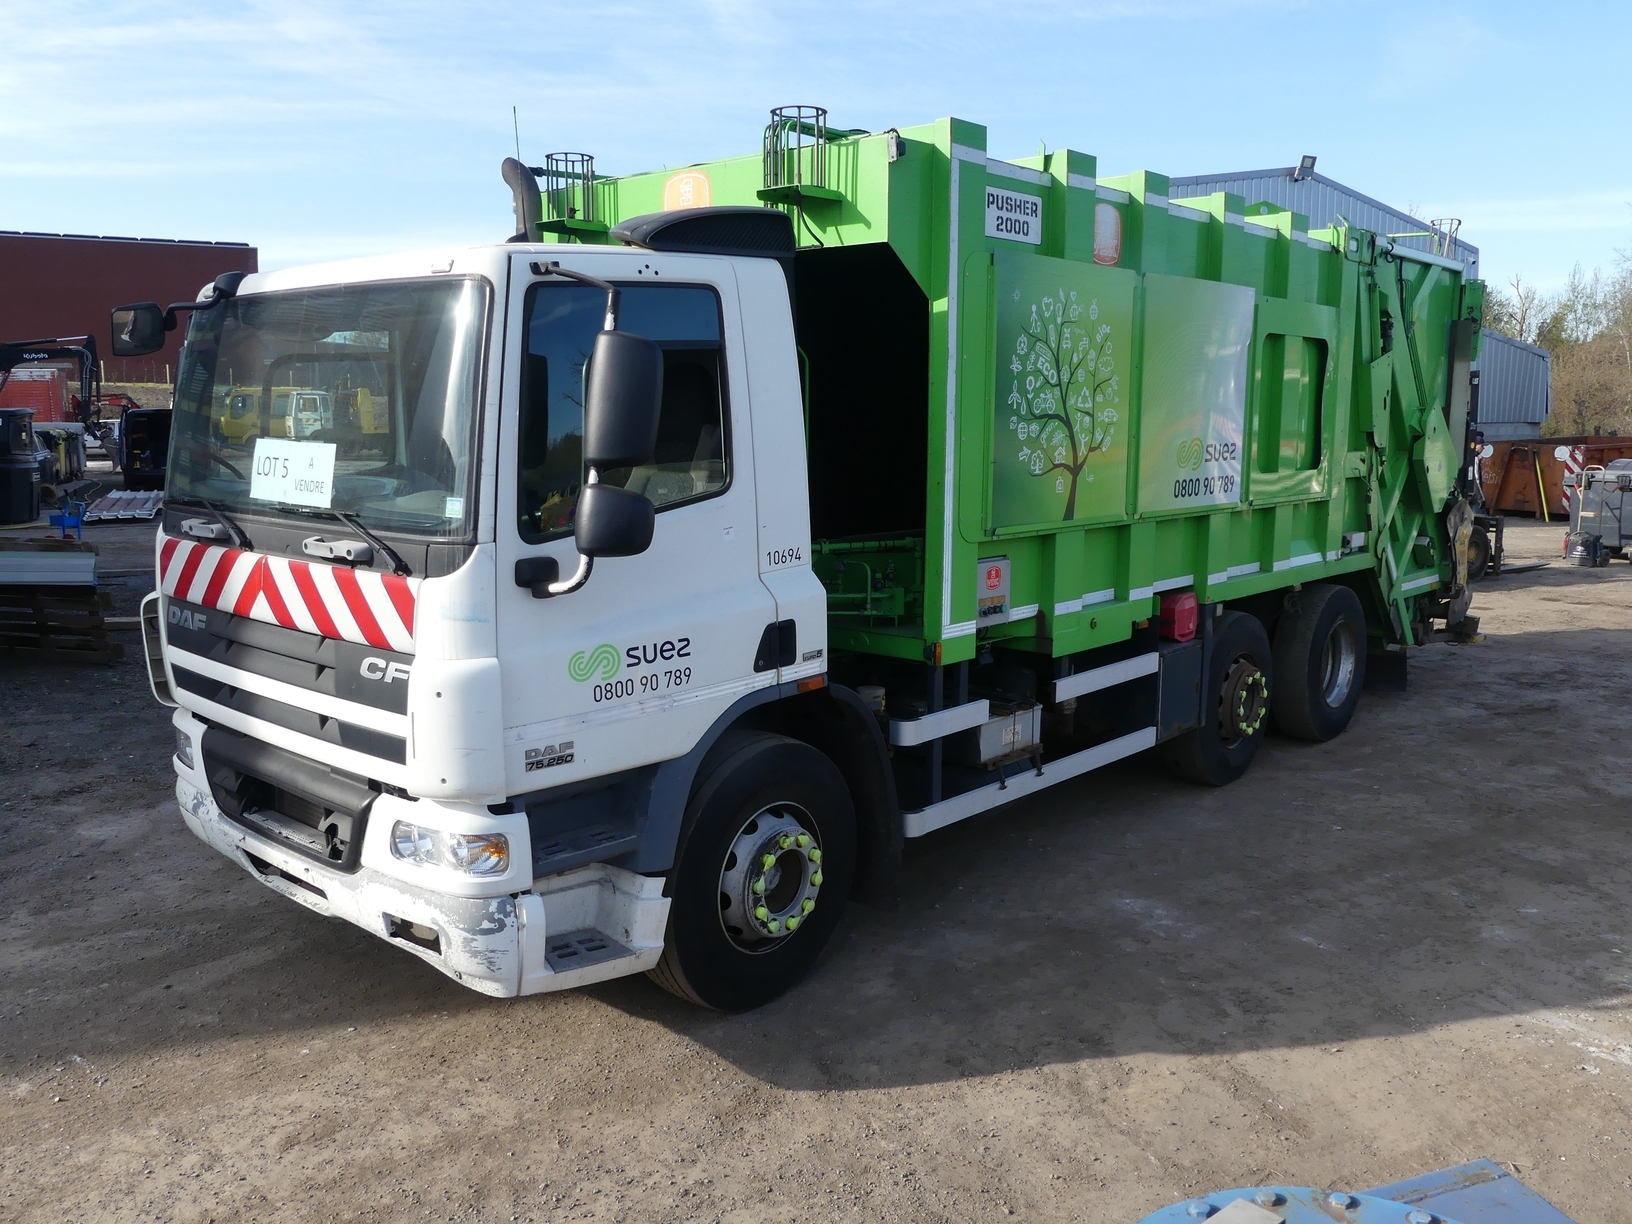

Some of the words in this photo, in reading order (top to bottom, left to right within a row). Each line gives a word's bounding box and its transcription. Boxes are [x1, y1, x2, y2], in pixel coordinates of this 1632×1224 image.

[987, 192, 1038, 218] PUSHER
[996, 215, 1029, 237] 2000
[1037, 357, 1057, 383] ECO
[257, 456, 280, 478] LOT
[281, 457, 290, 479] 5
[308, 456, 315, 470] A
[294, 478, 326, 494] VENDRE
[1173, 477, 1201, 499] 0800
[1203, 476, 1216, 496] 90
[1218, 474, 1235, 494] 789
[766, 547, 802, 567] 10694
[168, 605, 207, 631] DAF
[360, 656, 412, 684] CF
[593, 678, 635, 703] 0800
[640, 673, 659, 694] 90
[664, 666, 692, 689] 789
[525, 740, 575, 761] DAF
[526, 754, 574, 772] 75.250
